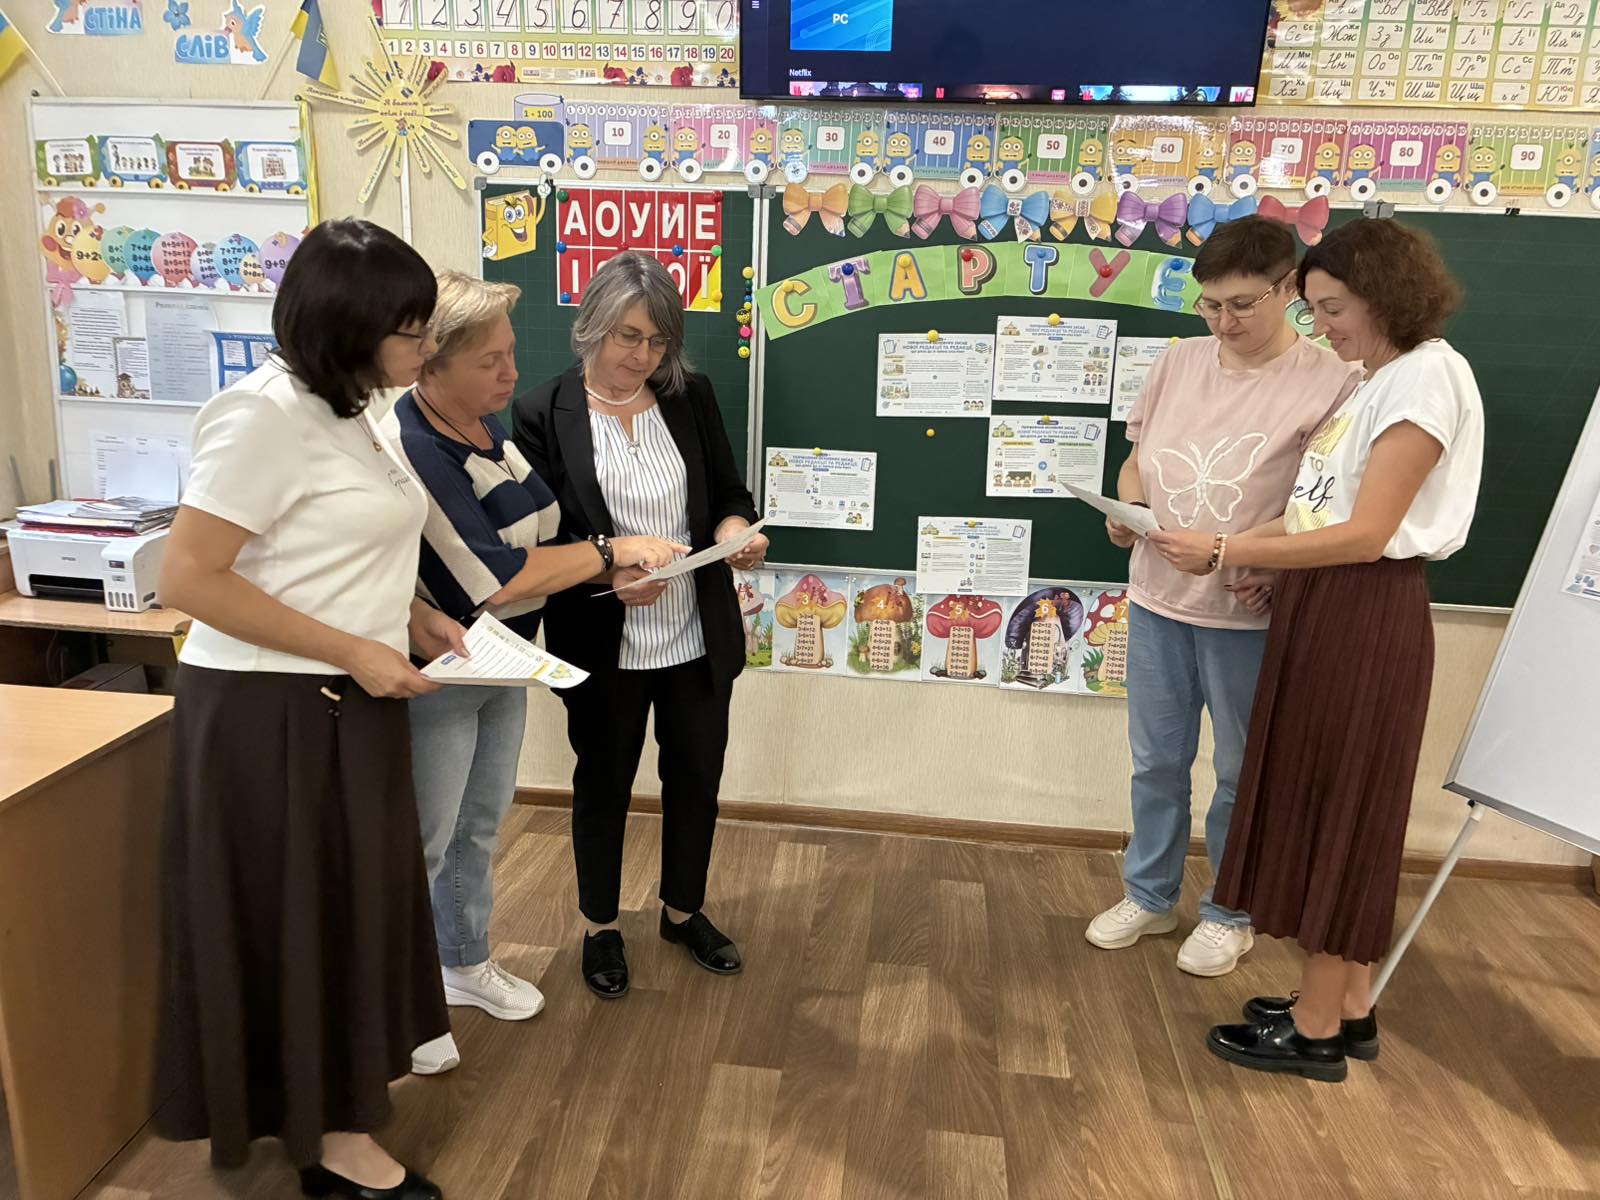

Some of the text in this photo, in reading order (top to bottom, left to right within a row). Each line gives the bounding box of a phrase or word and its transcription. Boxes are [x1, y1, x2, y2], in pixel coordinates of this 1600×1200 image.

[400, 0, 733, 30] 1 2 3 4 5 6 7 8 9 0
[833, 14, 849, 24] PC
[388, 42, 734, 59] 1 2 3 4 5 6 7 8 9 10 11 12 13 14 15 16 17 18 19 20
[790, 69, 812, 77] Netflix
[537, 110, 553, 118] 100
[612, 128, 1536, 161] 10 20 30 40 50 60 70 80 90
[1293, 476, 1336, 514] elf
[802, 595, 809, 605] 3
[877, 600, 885, 609] 4
[956, 605, 962, 614] 5
[1042, 604, 1049, 614] 6
[1120, 606, 1126, 616] 7
